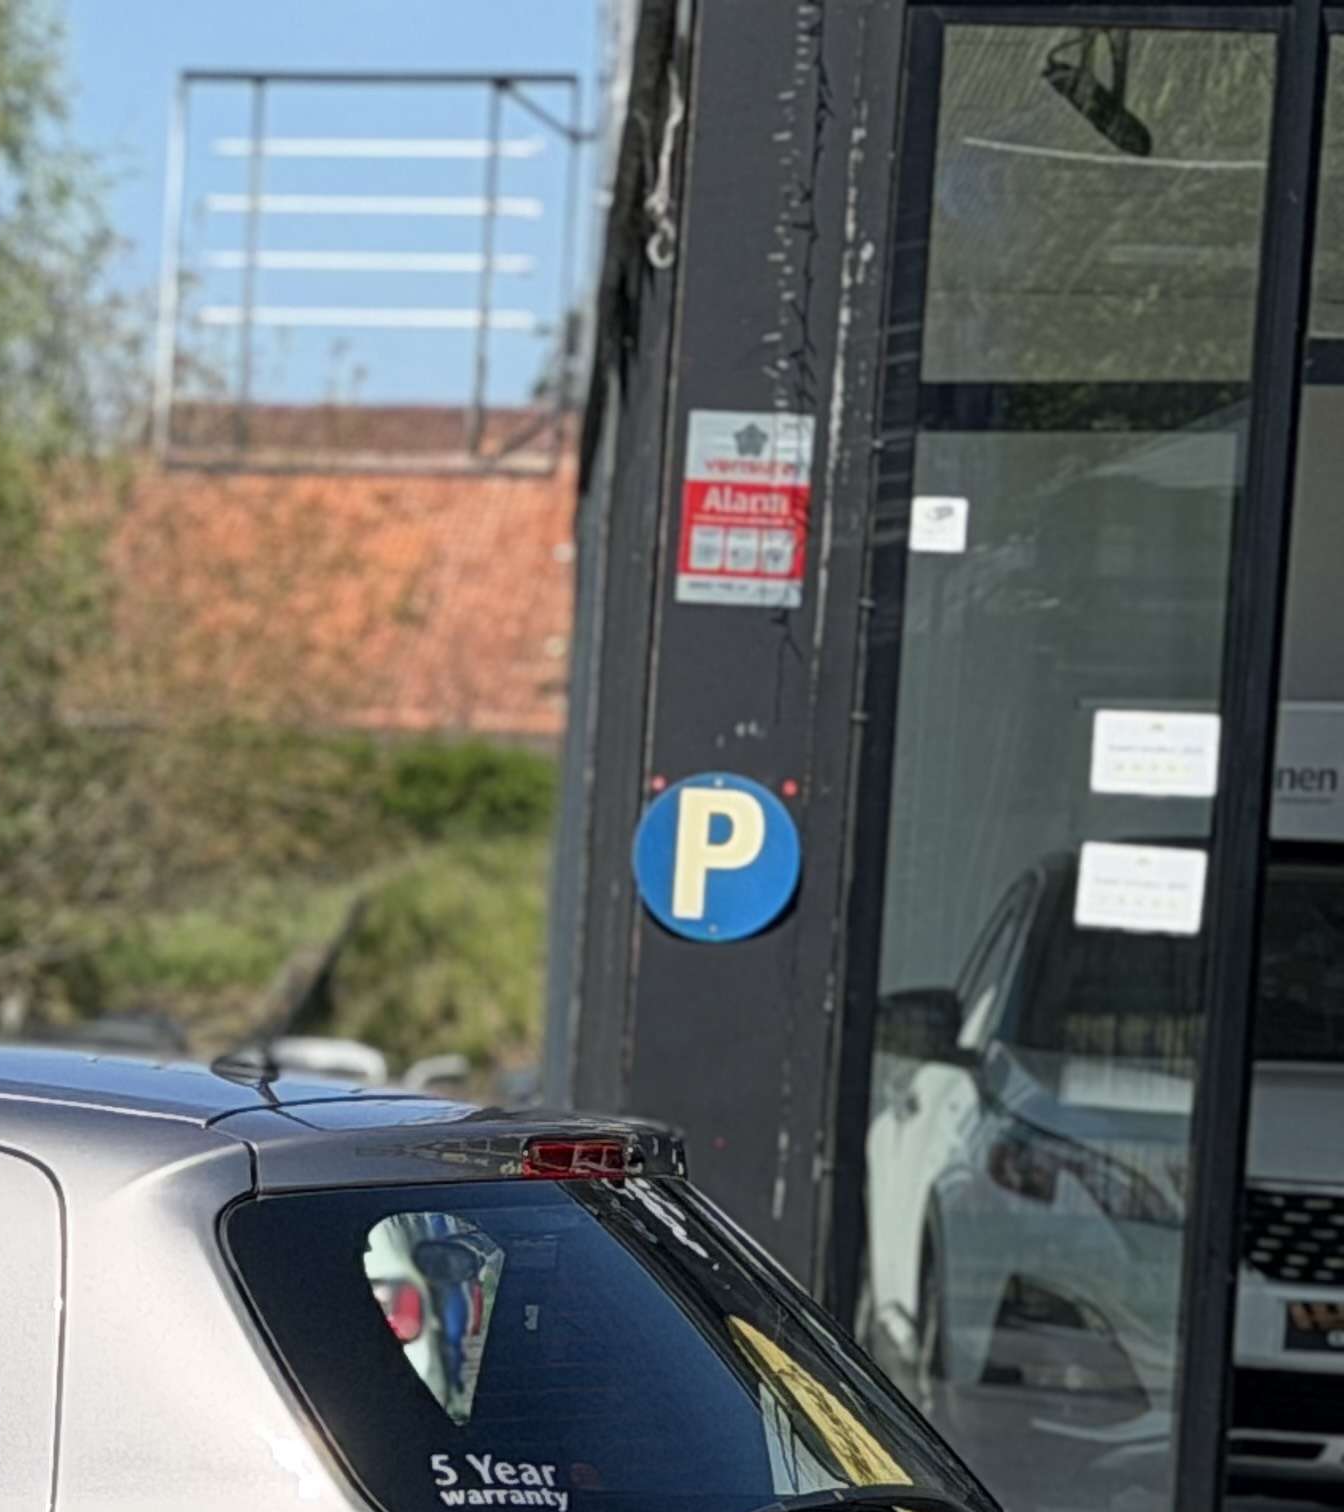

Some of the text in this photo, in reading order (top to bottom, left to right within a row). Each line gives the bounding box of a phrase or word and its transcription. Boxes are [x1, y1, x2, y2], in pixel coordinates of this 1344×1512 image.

[672, 786, 765, 920] P
[430, 1453, 556, 1487] 5 Year
[439, 1487, 569, 1512] warranty
